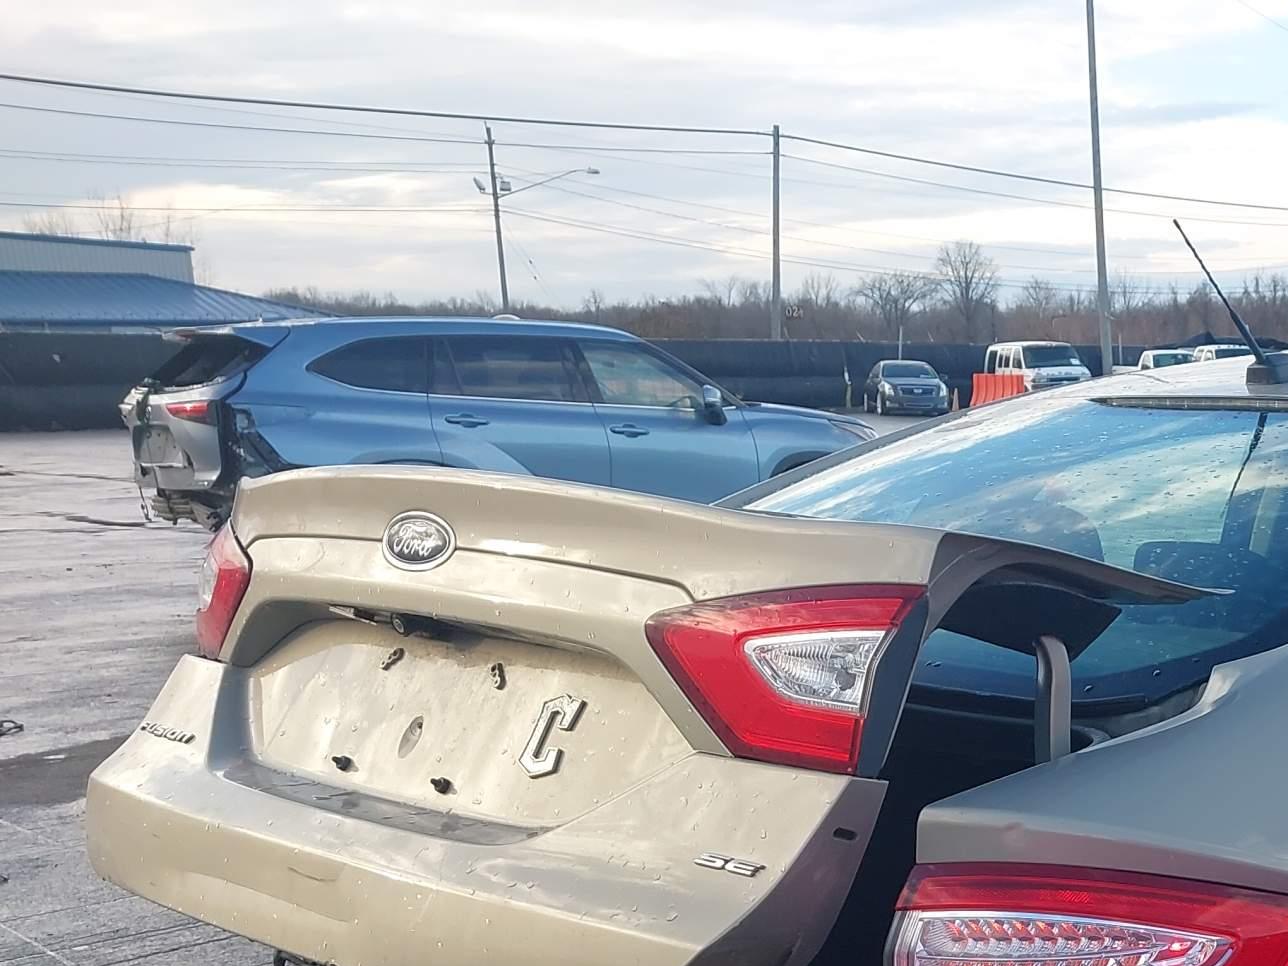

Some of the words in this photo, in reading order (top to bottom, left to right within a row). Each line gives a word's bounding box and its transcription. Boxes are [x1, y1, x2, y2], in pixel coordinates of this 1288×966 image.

[393, 523, 442, 557] Ford
[518, 693, 588, 779] C
[693, 853, 767, 878] SE
